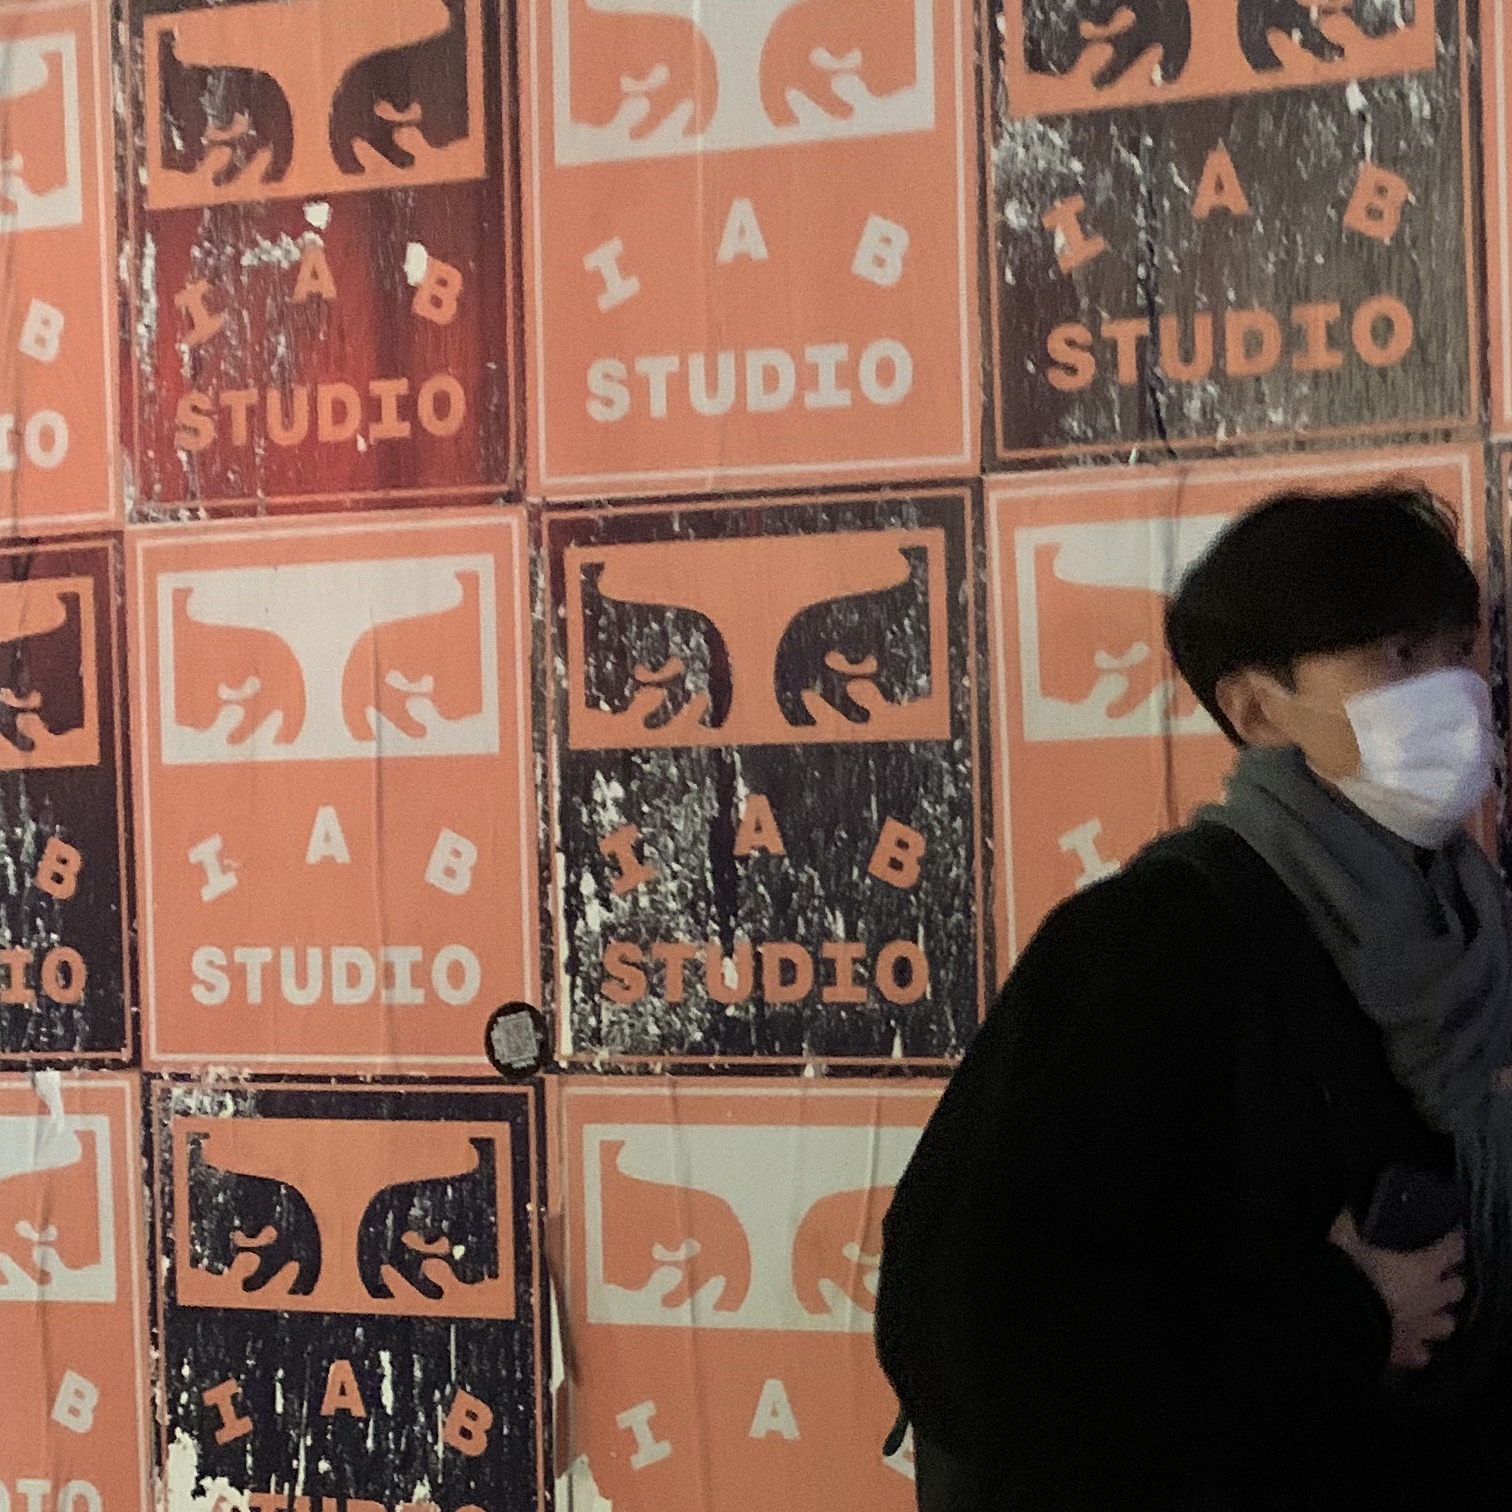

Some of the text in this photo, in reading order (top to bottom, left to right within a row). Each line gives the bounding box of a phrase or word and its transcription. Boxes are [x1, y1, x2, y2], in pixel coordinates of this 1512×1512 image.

[586, 339, 914, 421] STUDIO
[1047, 295, 1414, 391] STUDIO
[174, 373, 467, 450] STUDIO
[189, 943, 481, 1007] STUDIO
[601, 940, 931, 1005] STUDIO
